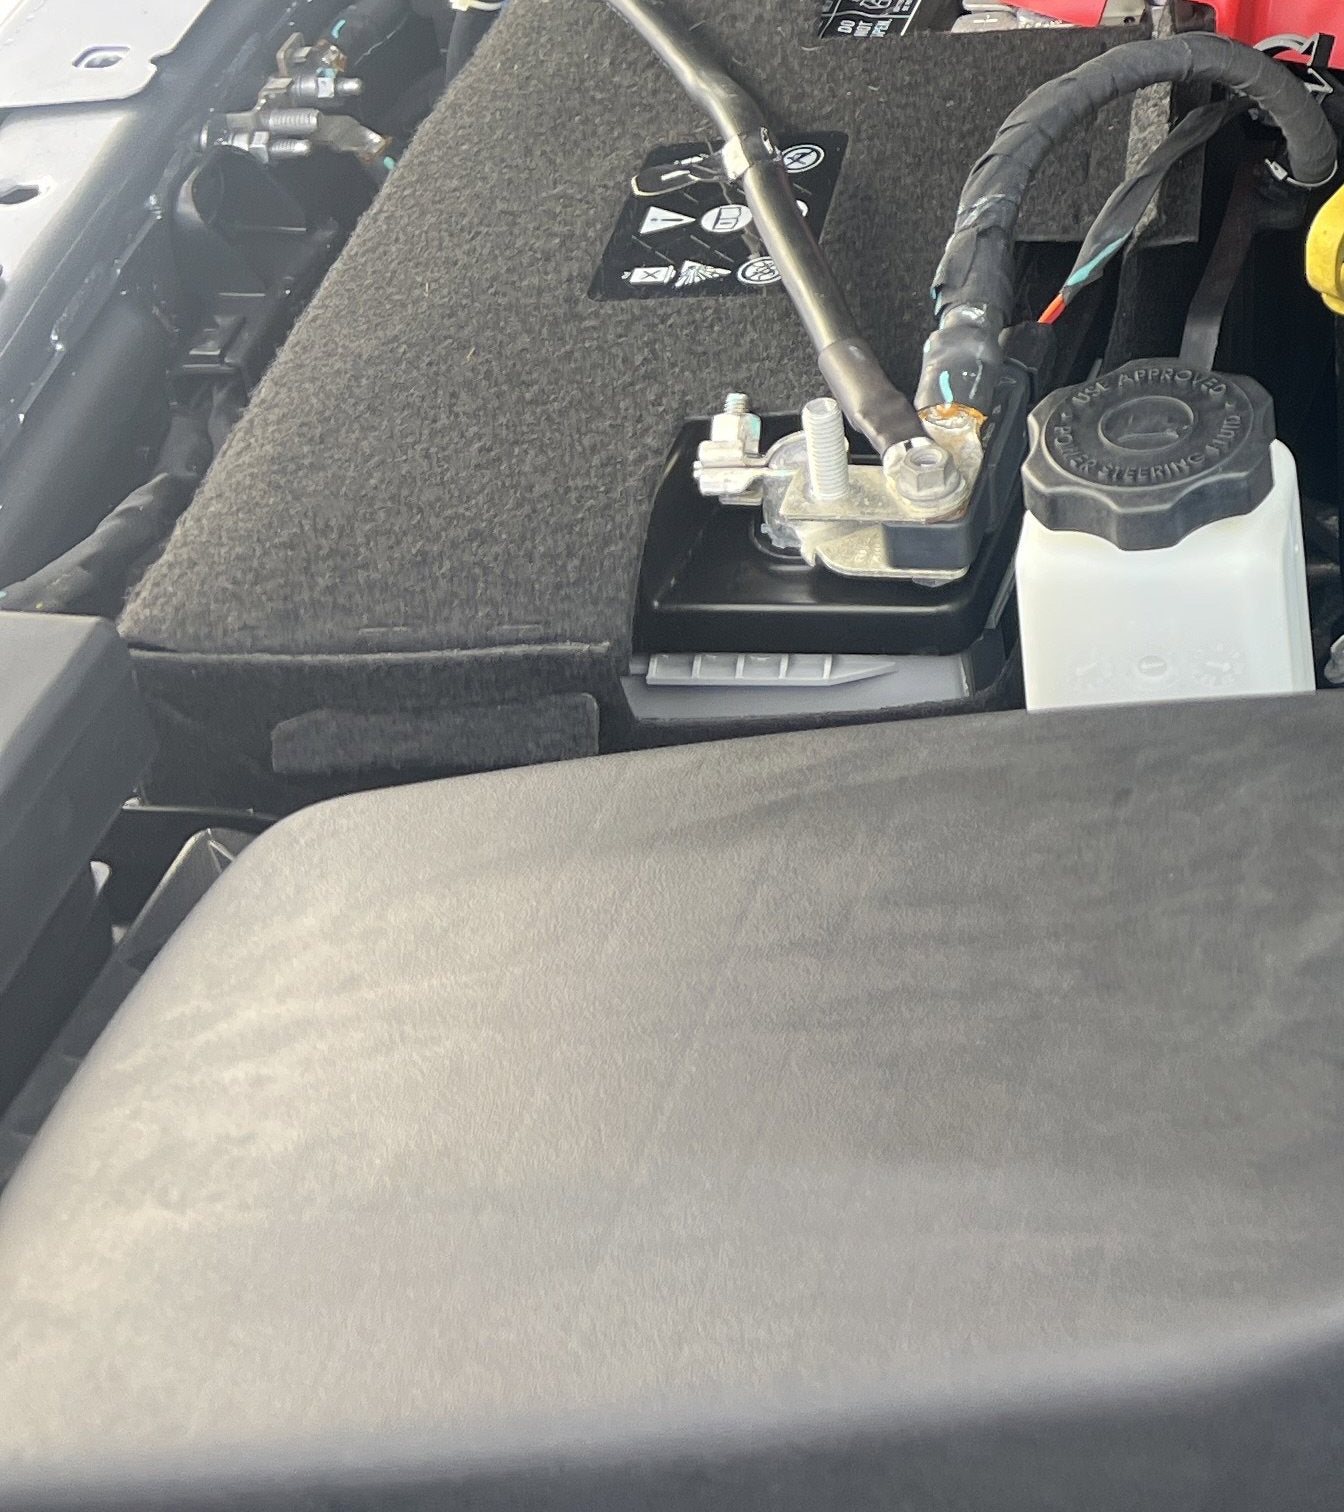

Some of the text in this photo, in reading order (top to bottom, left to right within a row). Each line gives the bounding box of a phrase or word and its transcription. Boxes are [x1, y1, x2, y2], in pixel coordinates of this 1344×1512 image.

[1071, 368, 1227, 406] USE APPROVED
[1054, 424, 1097, 473] POWER
[1098, 452, 1205, 480] STEERING
